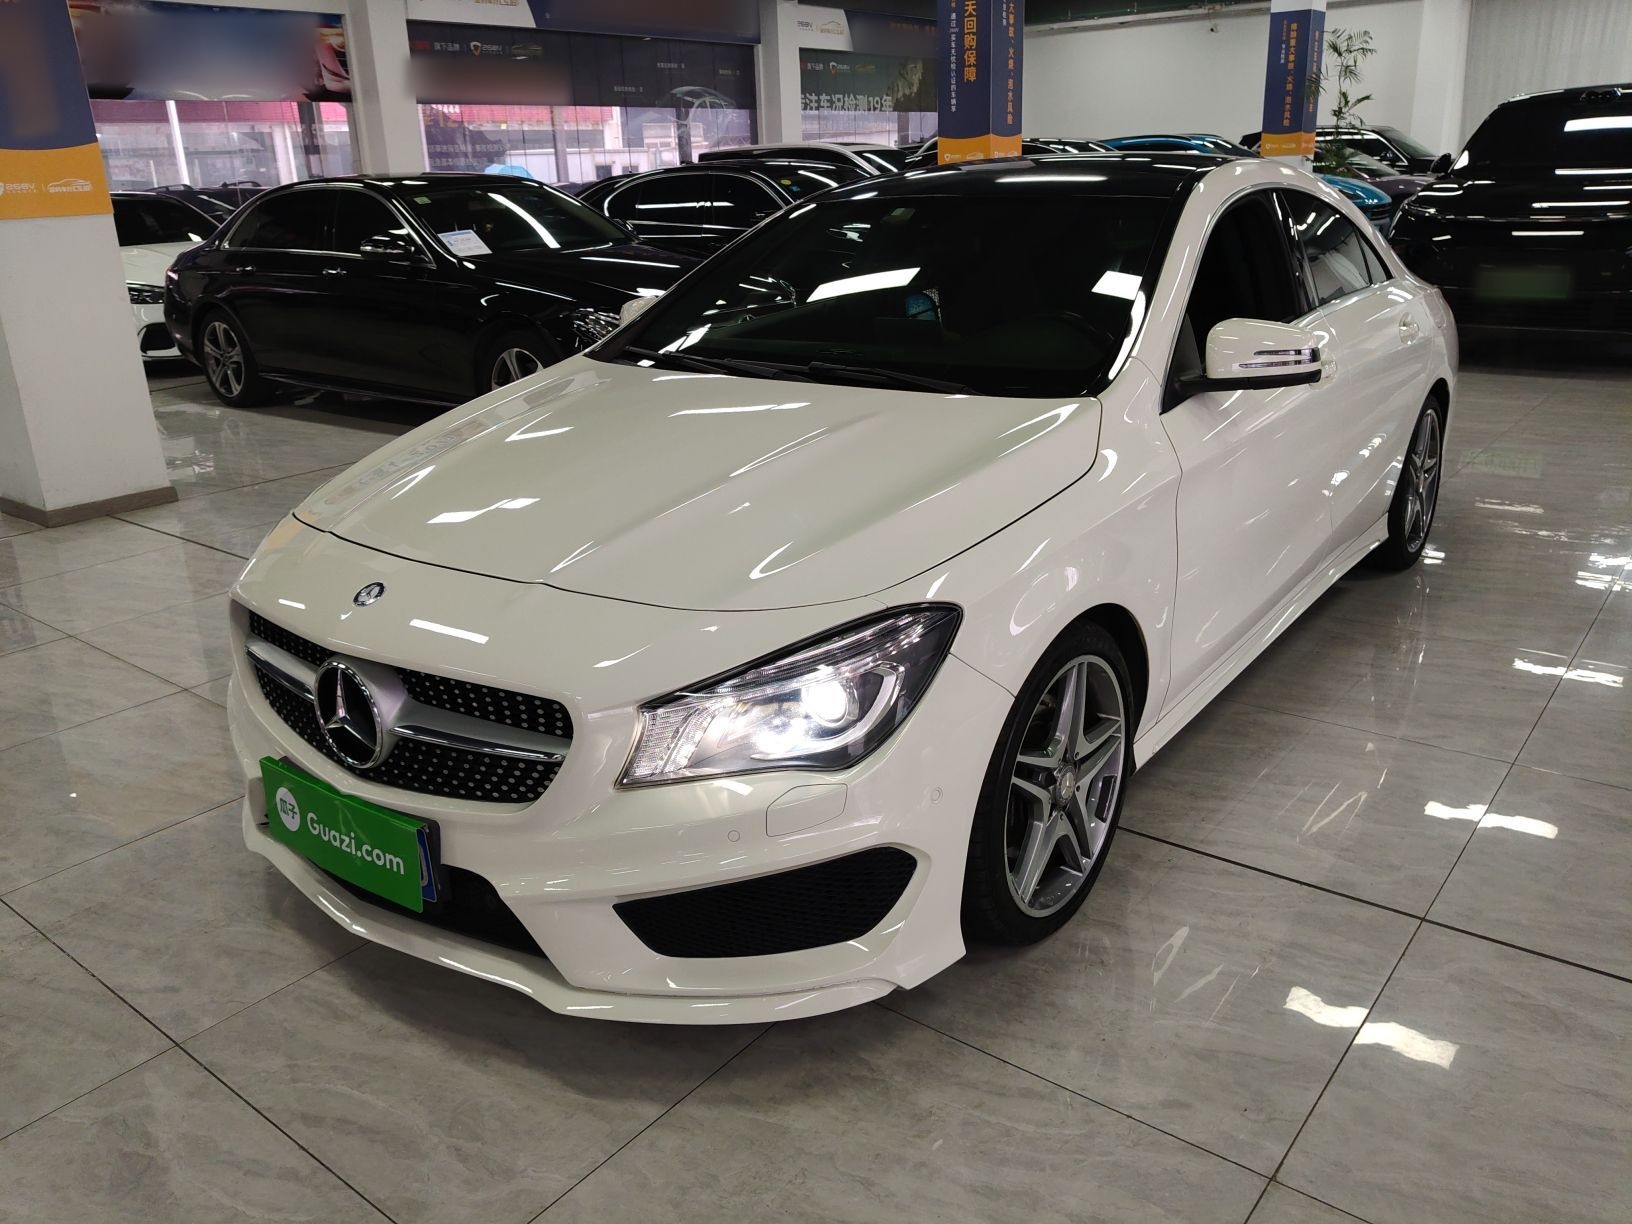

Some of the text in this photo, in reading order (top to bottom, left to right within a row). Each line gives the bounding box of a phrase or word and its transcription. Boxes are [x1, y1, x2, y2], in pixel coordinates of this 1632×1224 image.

[964, 1, 977, 82] 天回购保障
[279, 797, 298, 820] 瓜子
[306, 812, 405, 875] Guazi.com
